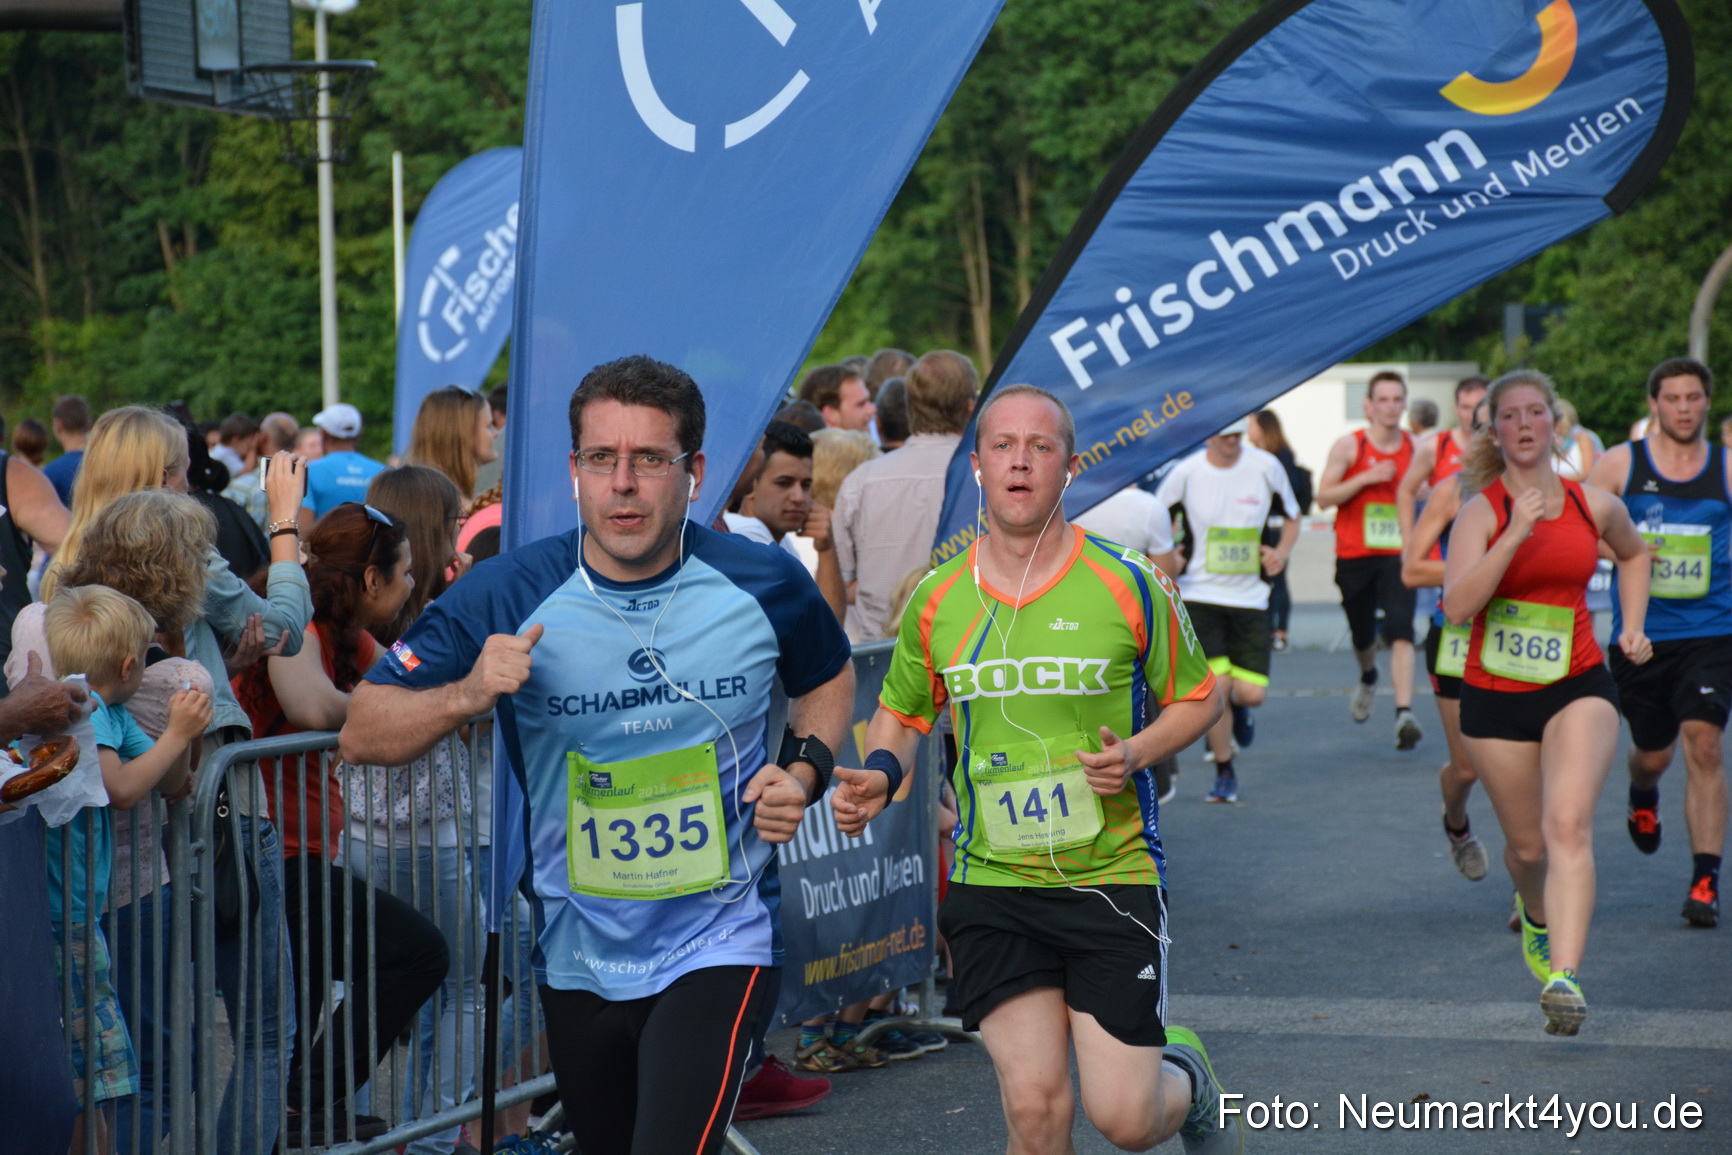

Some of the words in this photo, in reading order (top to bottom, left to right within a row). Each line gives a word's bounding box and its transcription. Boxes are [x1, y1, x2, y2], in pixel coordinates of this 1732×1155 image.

[1330, 209, 1437, 281] Druck
[1443, 173, 1509, 220] und
[1510, 96, 1644, 188] Medien
[1049, 128, 1488, 391] Frischmann
[1217, 545, 1251, 562] 385
[1651, 559, 1704, 580] 344
[1494, 629, 1562, 662] 1368
[547, 675, 747, 717] SCHABMÜLLER
[943, 656, 1111, 703] BOCK
[621, 717, 673, 736] TEAM
[998, 782, 1070, 825] 141
[581, 804, 709, 862] 1335
[1017, 833, 1034, 841] Jens
[612, 871, 644, 881] Martin
[645, 868, 678, 880] Hafner
[800, 867, 848, 920] Druck
[847, 857, 880, 907] und
